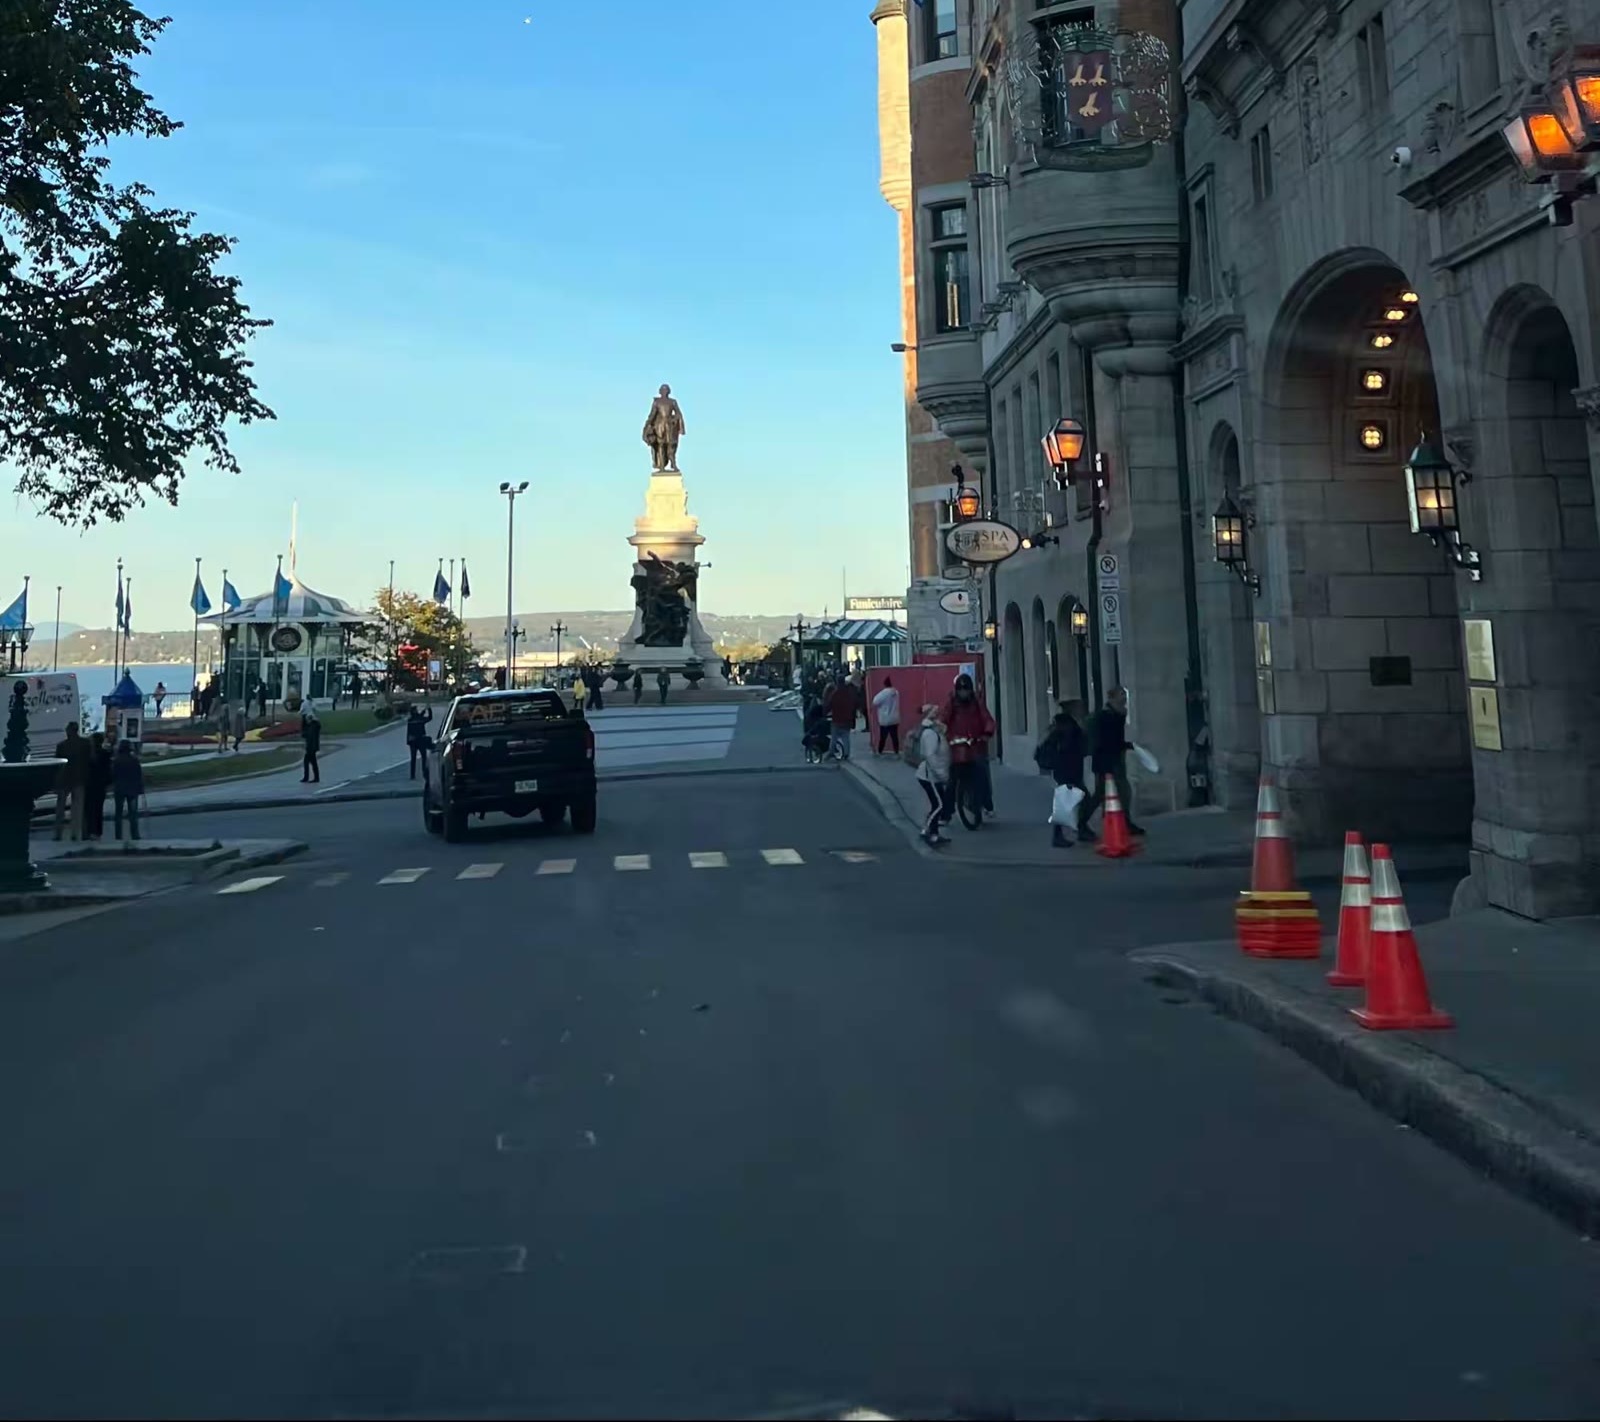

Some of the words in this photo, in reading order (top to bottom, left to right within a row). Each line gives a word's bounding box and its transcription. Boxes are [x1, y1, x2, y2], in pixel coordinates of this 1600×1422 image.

[982, 530, 1009, 542] SPA
[850, 598, 903, 610] Funiculaire
[8, 690, 73, 708] Ecellence
